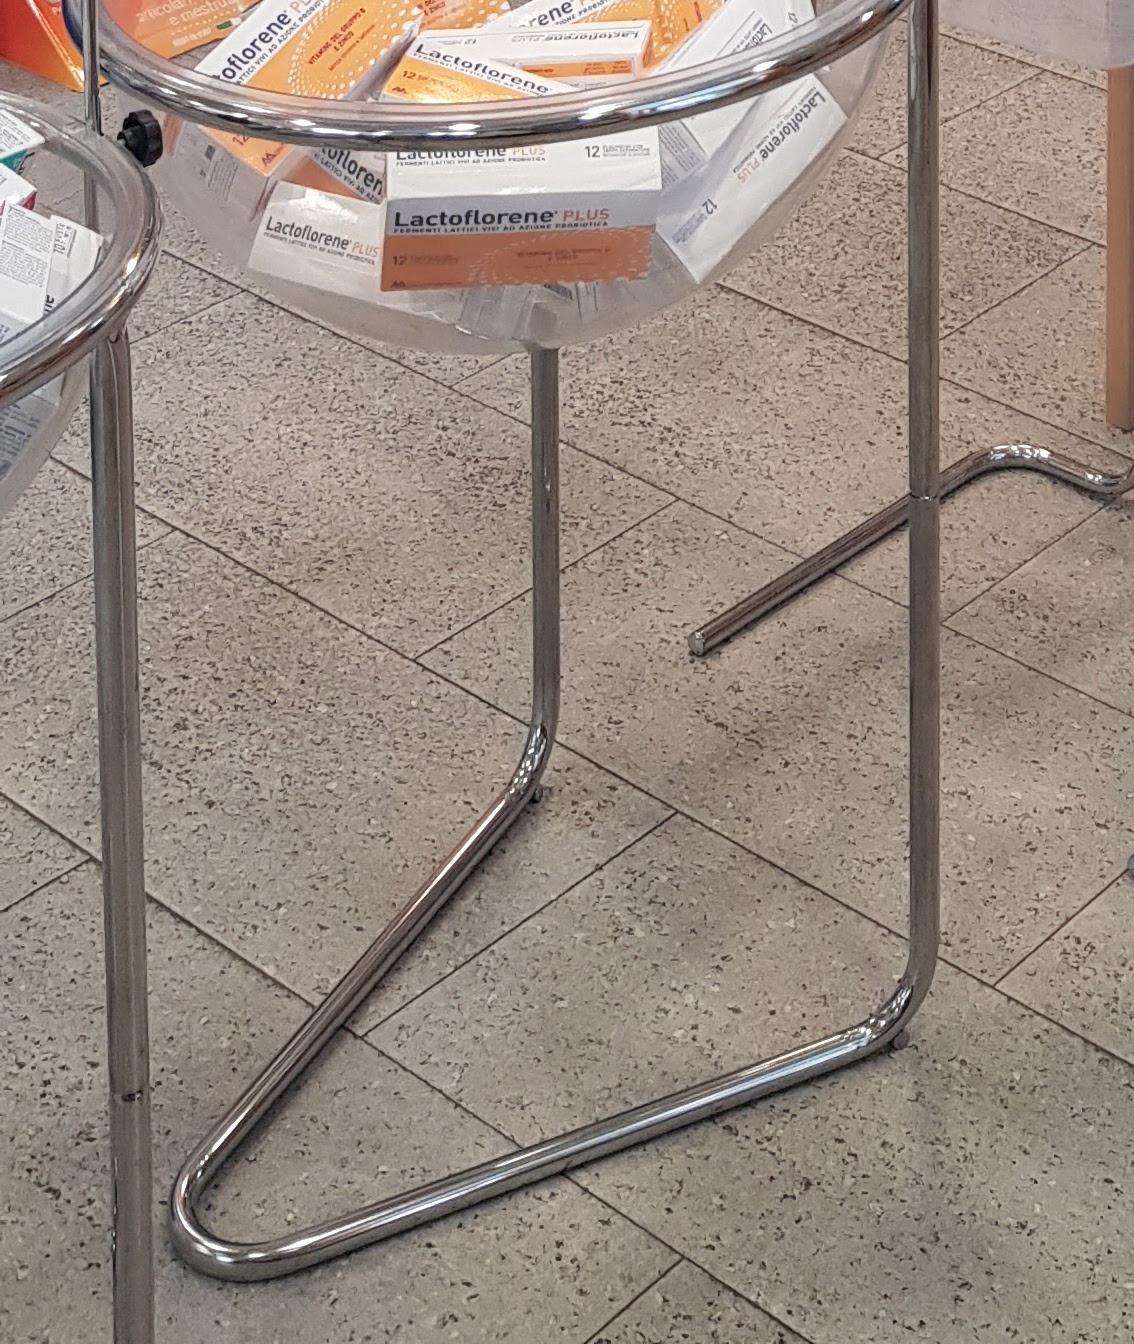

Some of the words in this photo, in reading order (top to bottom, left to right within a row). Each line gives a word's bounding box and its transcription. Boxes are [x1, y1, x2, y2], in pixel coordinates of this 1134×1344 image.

[416, 44, 551, 95] Lactoflorene
[758, 91, 827, 160] Lactoflorene
[265, 216, 350, 250] Lactoflorene
[394, 210, 555, 227] Lactoflorene
[563, 208, 610, 222] PLUS
